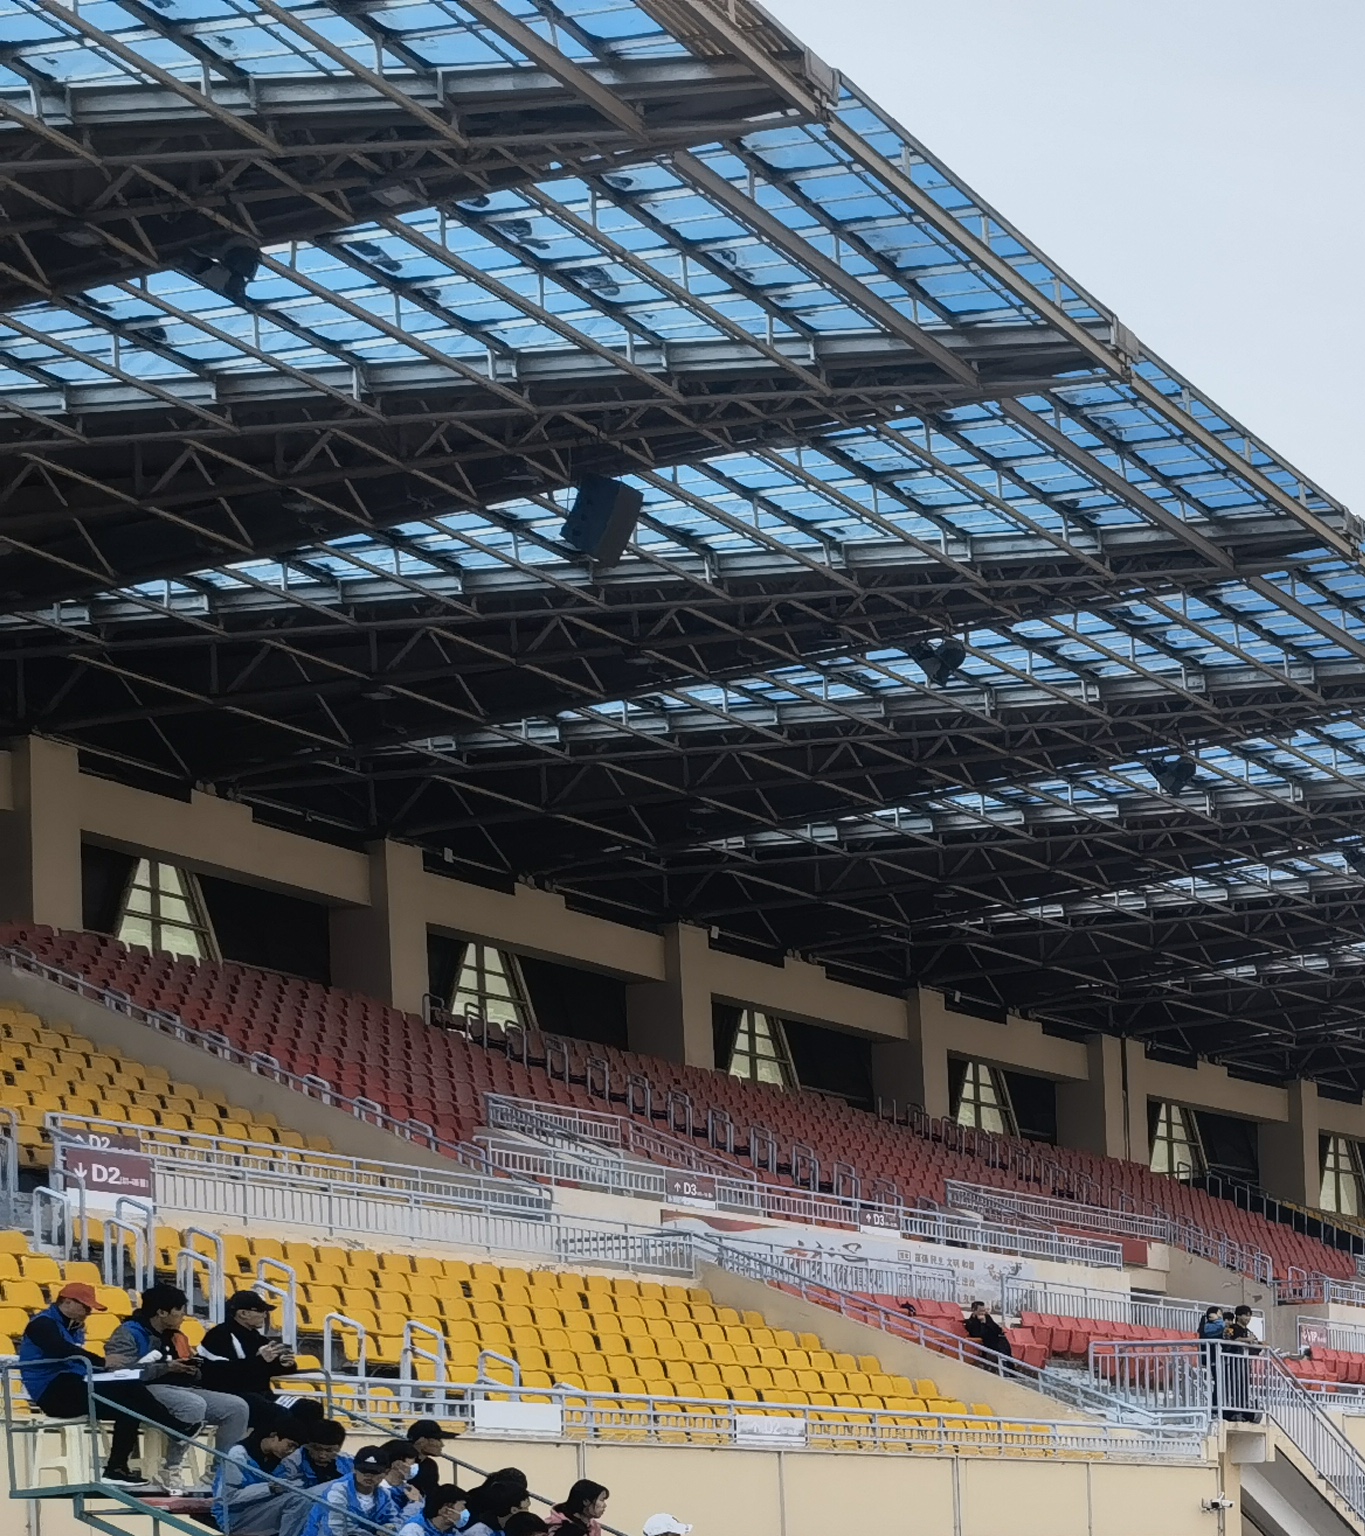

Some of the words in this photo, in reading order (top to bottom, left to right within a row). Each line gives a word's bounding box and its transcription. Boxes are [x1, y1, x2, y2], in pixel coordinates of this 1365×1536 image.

[91, 1164, 121, 1185] D2
[683, 1181, 697, 1196] D3
[873, 1213, 885, 1226] D3
